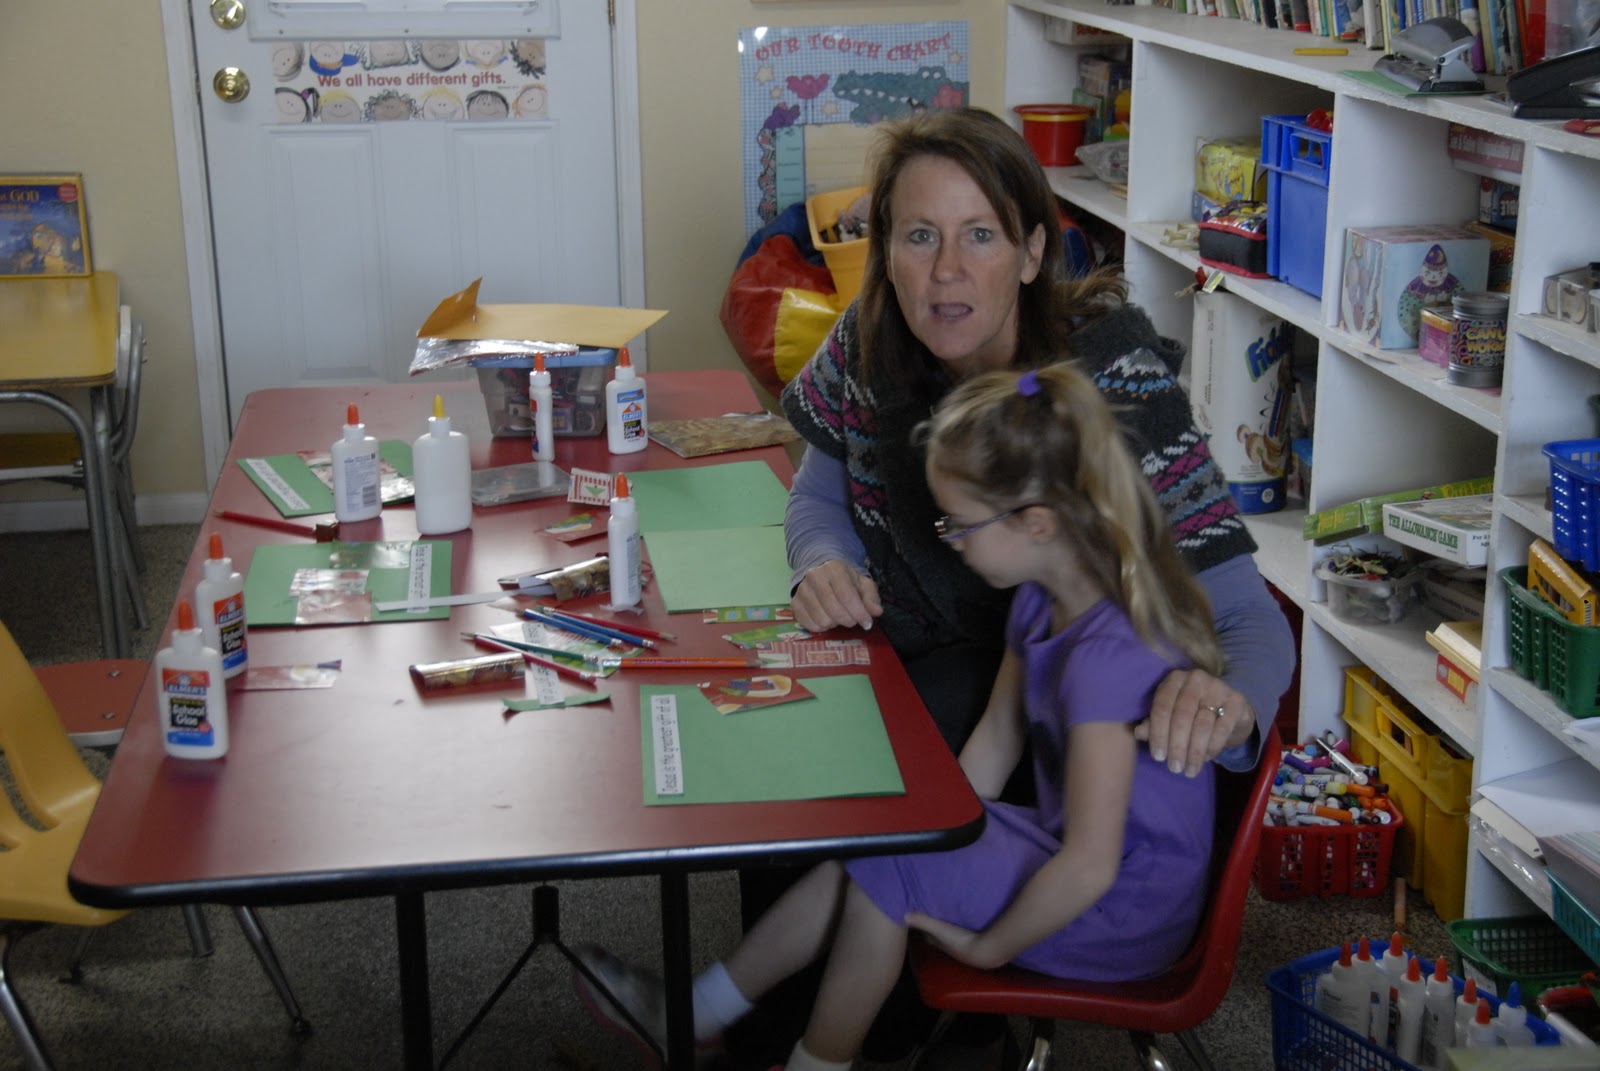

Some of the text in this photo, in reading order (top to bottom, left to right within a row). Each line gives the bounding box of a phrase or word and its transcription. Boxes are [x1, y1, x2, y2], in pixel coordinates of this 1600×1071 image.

[756, 32, 951, 62] OUR TOOTH CHART
[317, 72, 506, 87] We all have different gifts.
[1388, 513, 1458, 549] THE ALLOWANCE GAME
[169, 685, 206, 695] ELMER'S
[173, 704, 205, 716] School
[176, 714, 198, 725] Glue
